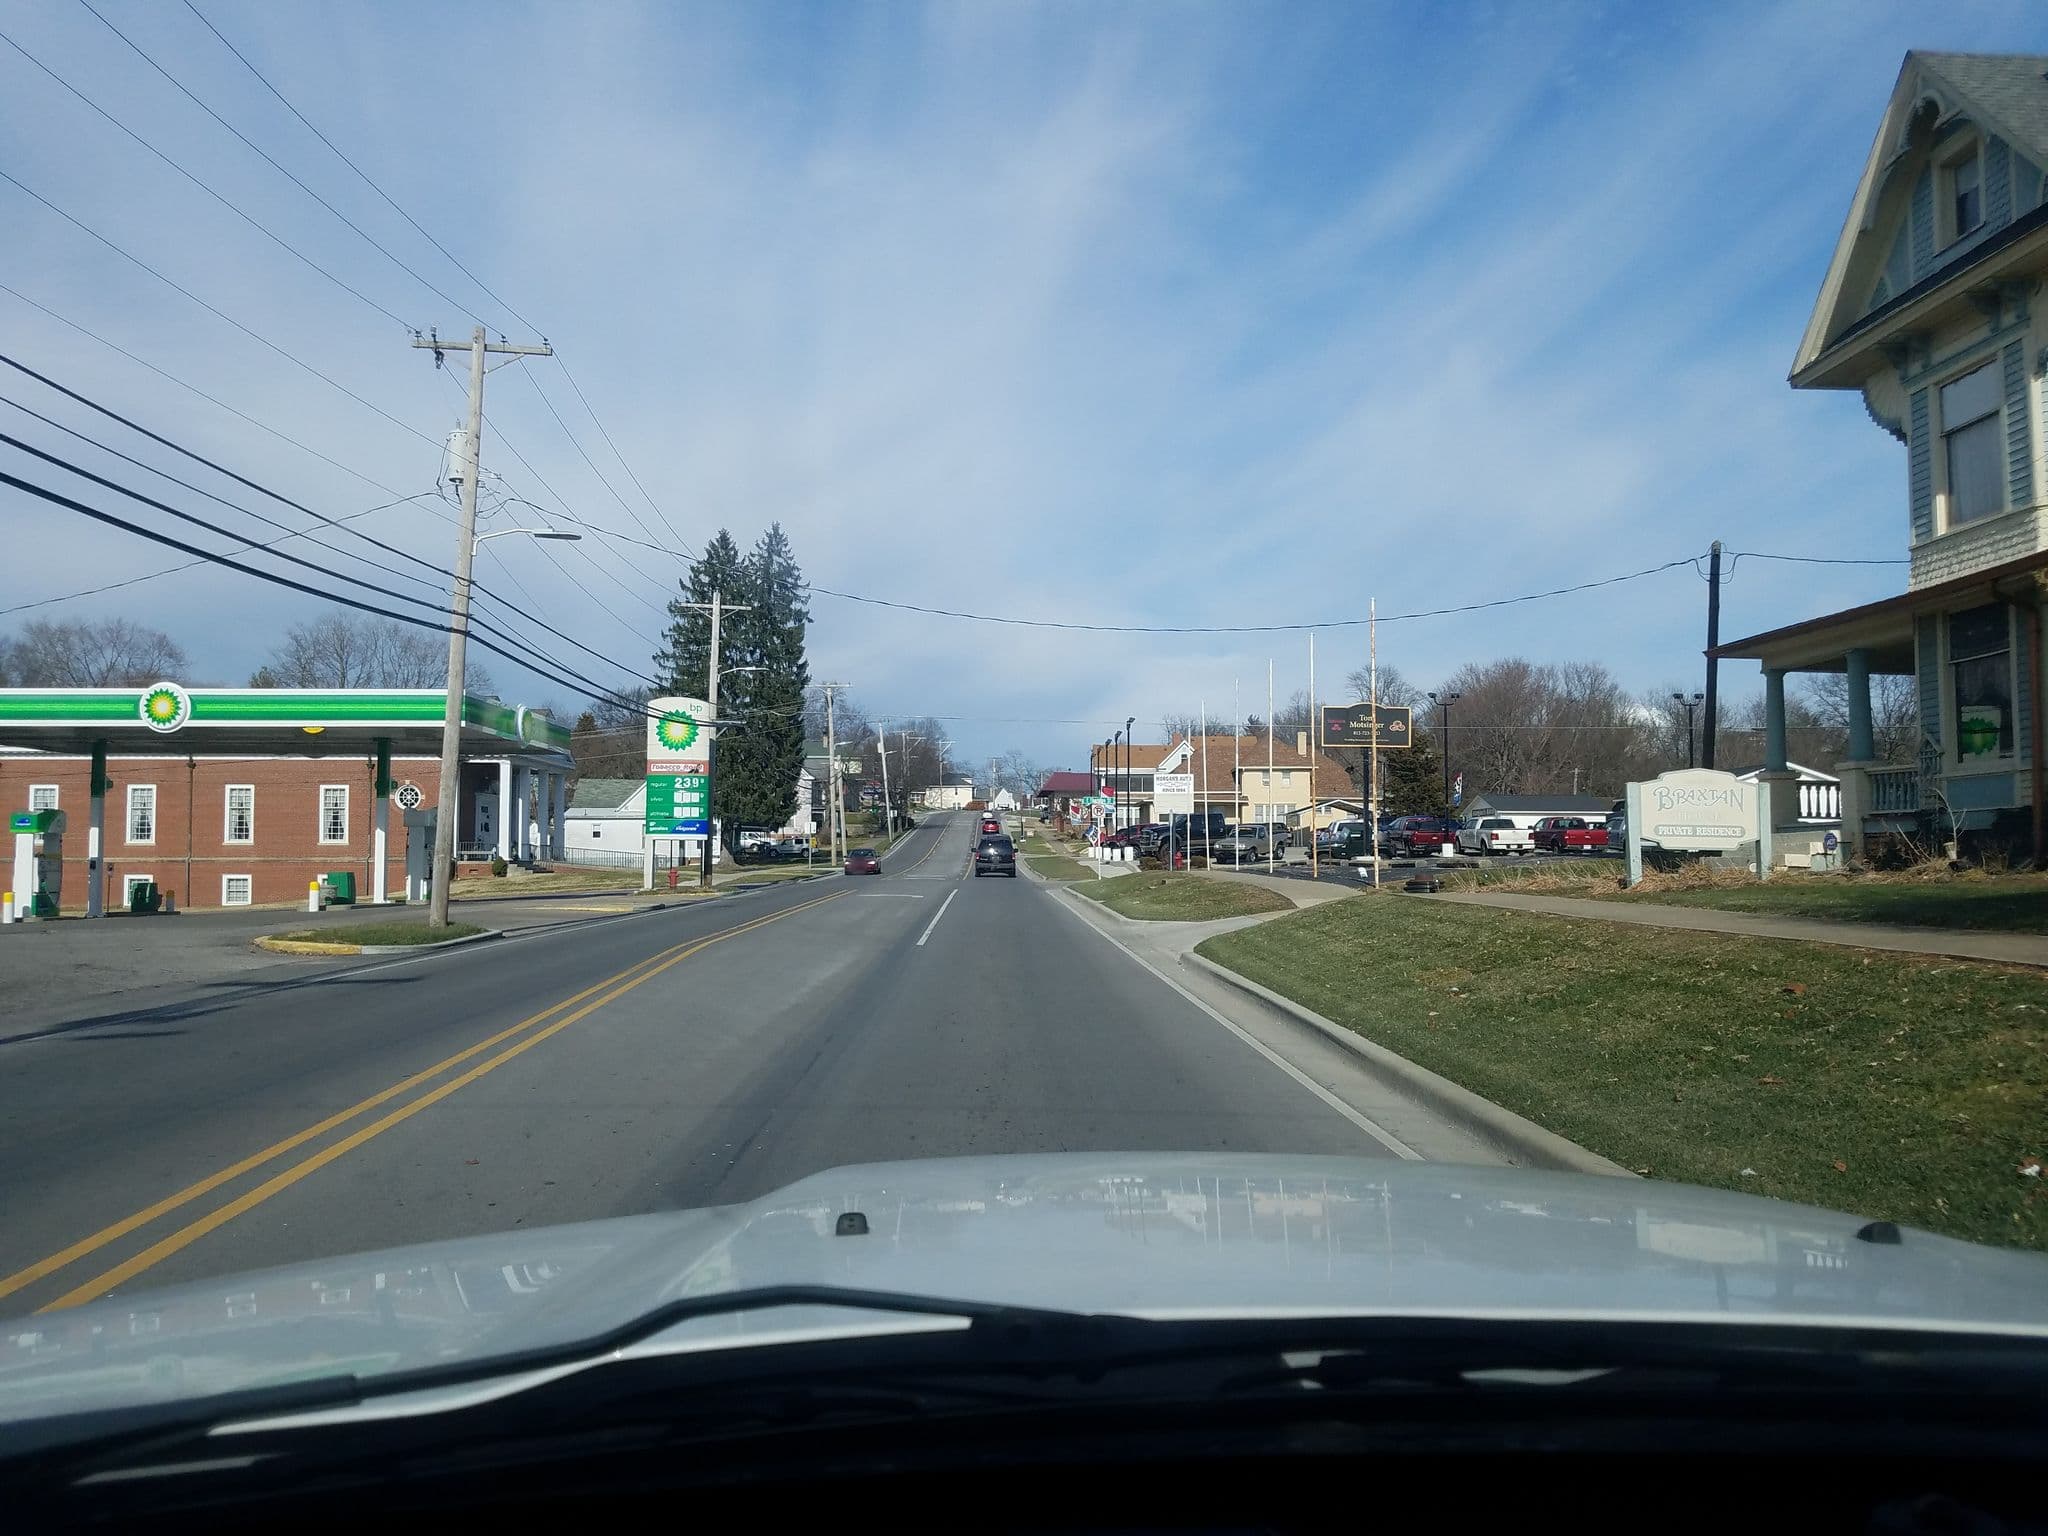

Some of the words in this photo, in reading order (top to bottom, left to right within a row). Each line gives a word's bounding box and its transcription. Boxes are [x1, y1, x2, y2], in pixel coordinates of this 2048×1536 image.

[1653, 786, 1744, 813] BRAXTAN
[1659, 826, 1693, 835] PRIVATE
[1696, 827, 1742, 836] RESIDENCE
